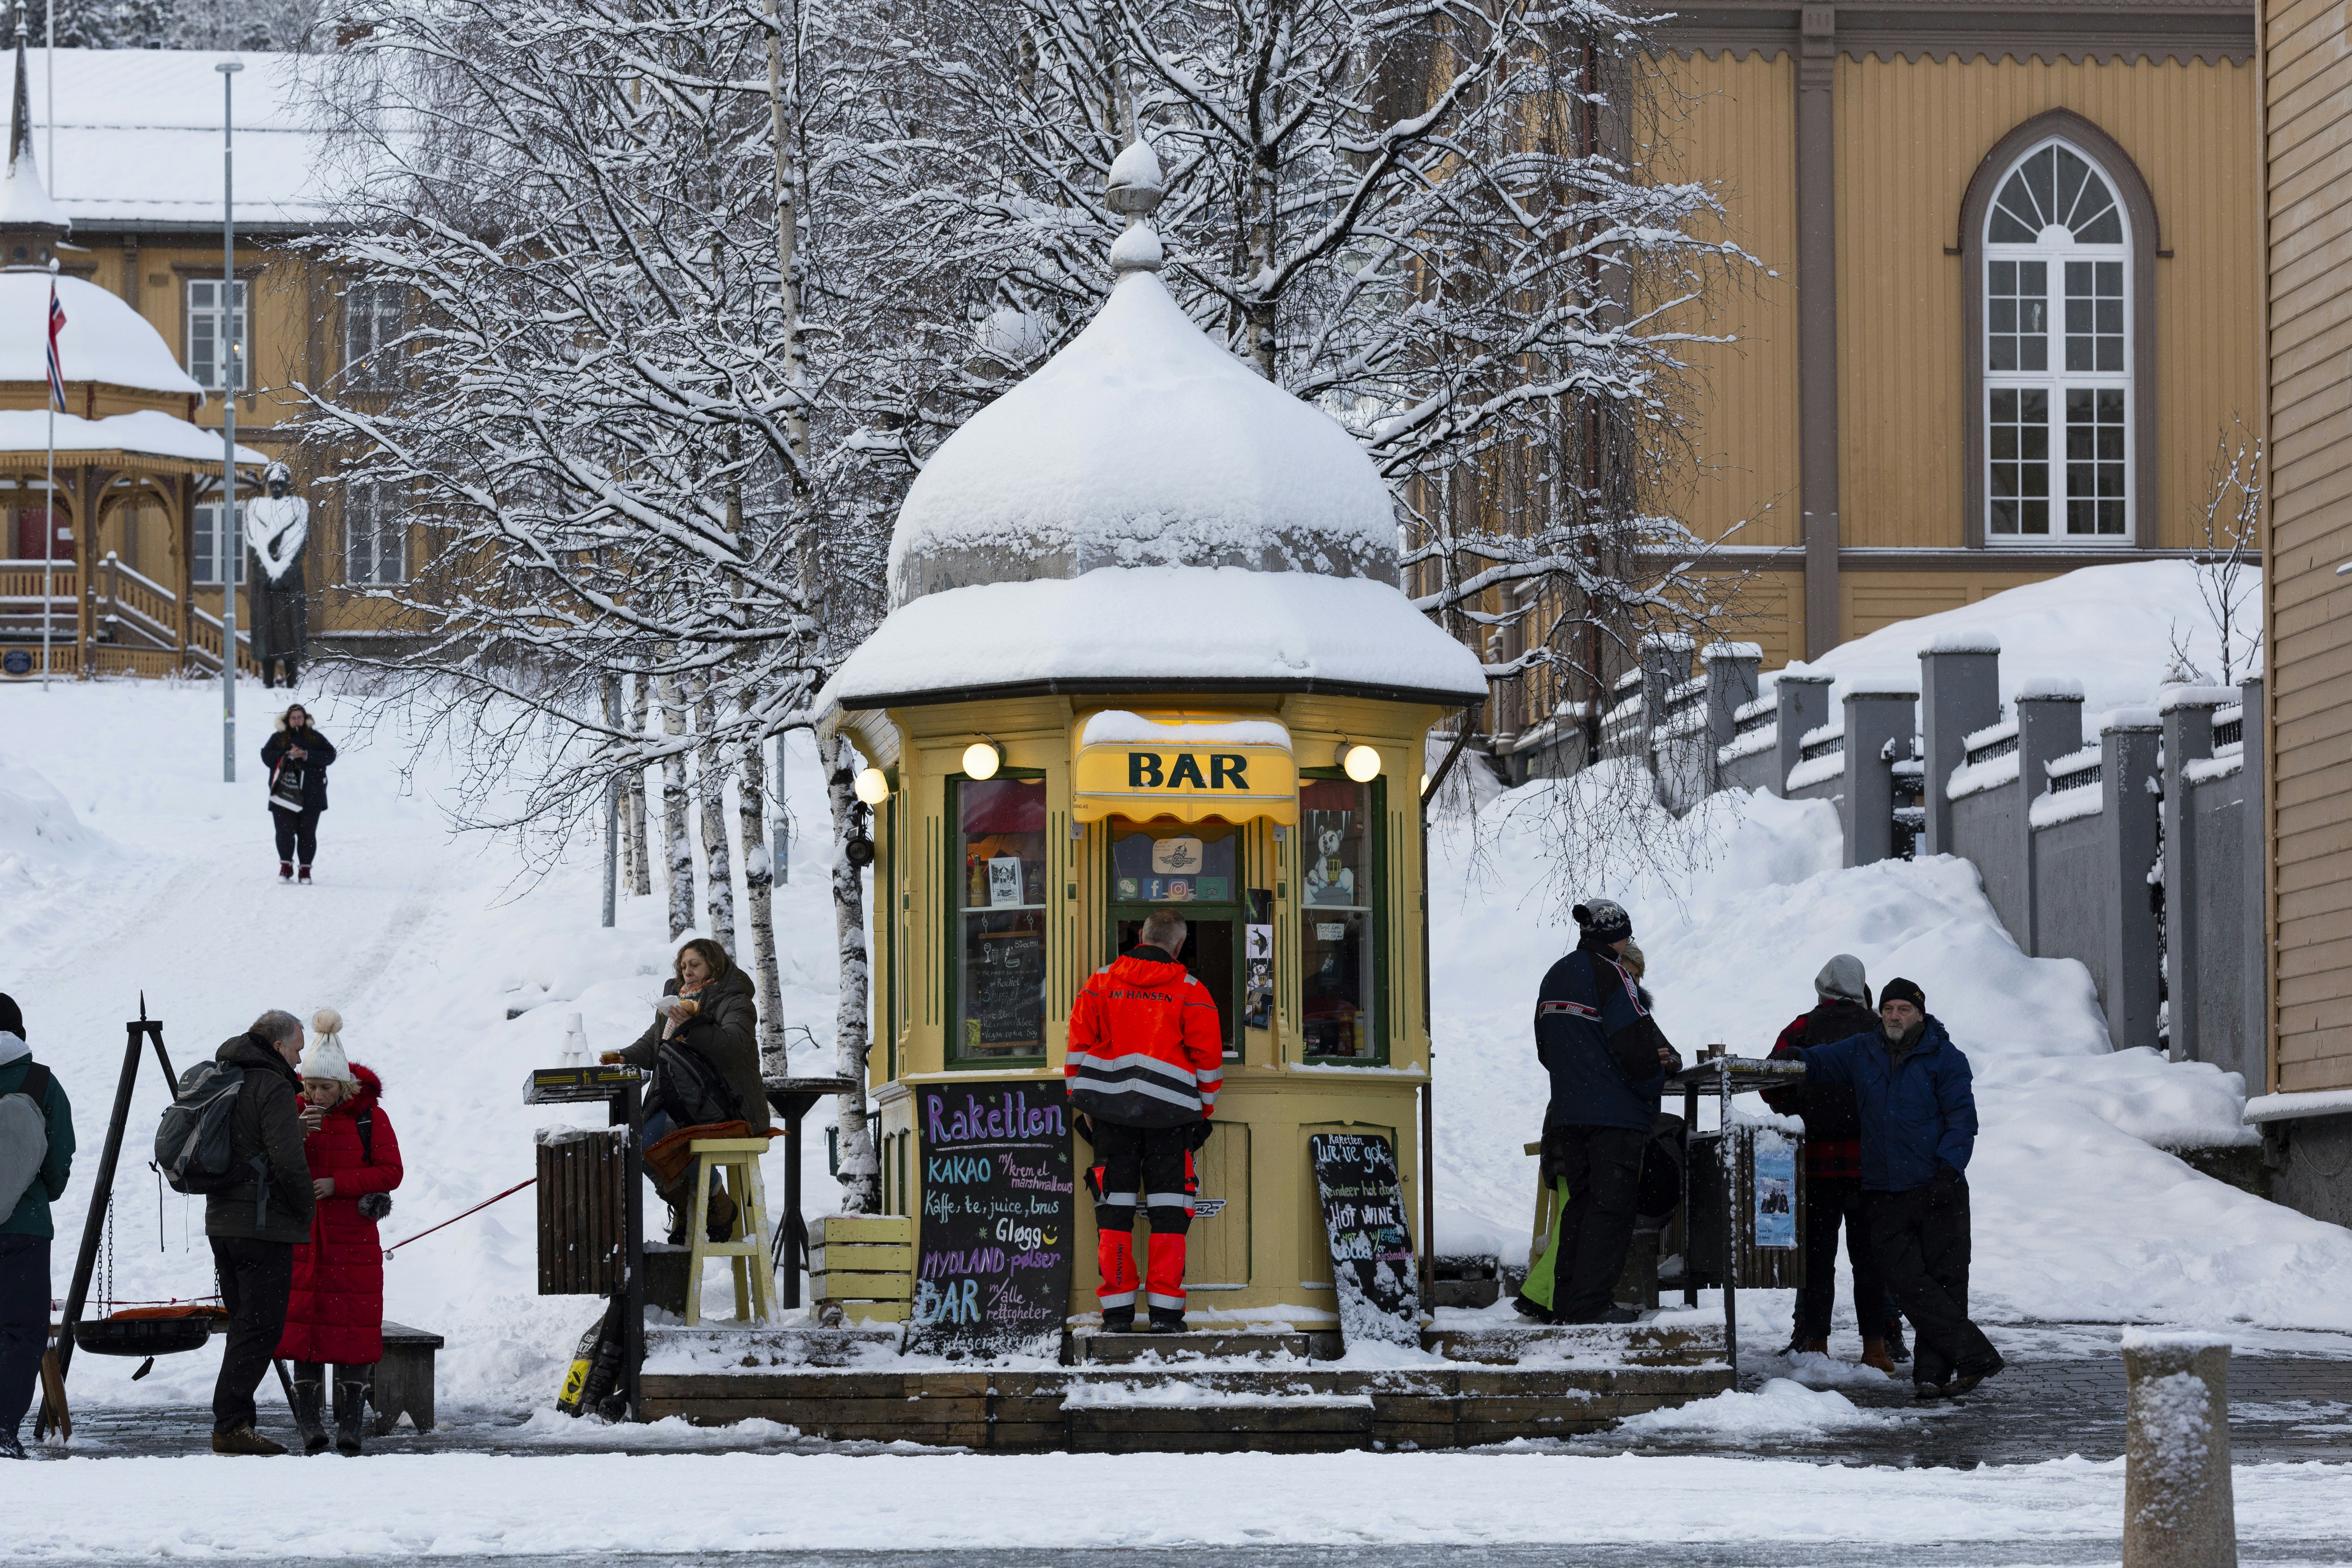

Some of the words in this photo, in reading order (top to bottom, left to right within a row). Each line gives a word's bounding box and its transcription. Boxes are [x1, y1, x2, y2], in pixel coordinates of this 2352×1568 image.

[1129, 753, 1250, 789] BAR
[982, 989, 990, 1002] 3
[1108, 990, 1123, 998] JM
[1127, 990, 1173, 1002] HANSEN
[928, 1091, 1066, 1144] Raketten
[1329, 1134, 1364, 1145] Raketten
[1313, 1136, 1360, 1163] We've
[1364, 1140, 1384, 1173] got
[928, 1156, 991, 1184] KAKAO
[1011, 1176, 1073, 1194] marshmallows
[1361, 1180, 1377, 1196] hot
[925, 1189, 960, 1224] Kaffe,
[965, 1195, 986, 1214] te,
[1330, 1201, 1357, 1229] HOT
[1361, 1206, 1394, 1225] WINE
[996, 1218, 1041, 1251] Gløgg
[1342, 1233, 1357, 1241] HOT
[1381, 1234, 1402, 1244] cream
[1118, 1242, 1123, 1253] JM
[1377, 1245, 1385, 1253] or
[920, 1279, 981, 1325] BAR
[986, 1301, 1052, 1329] rettigheter
